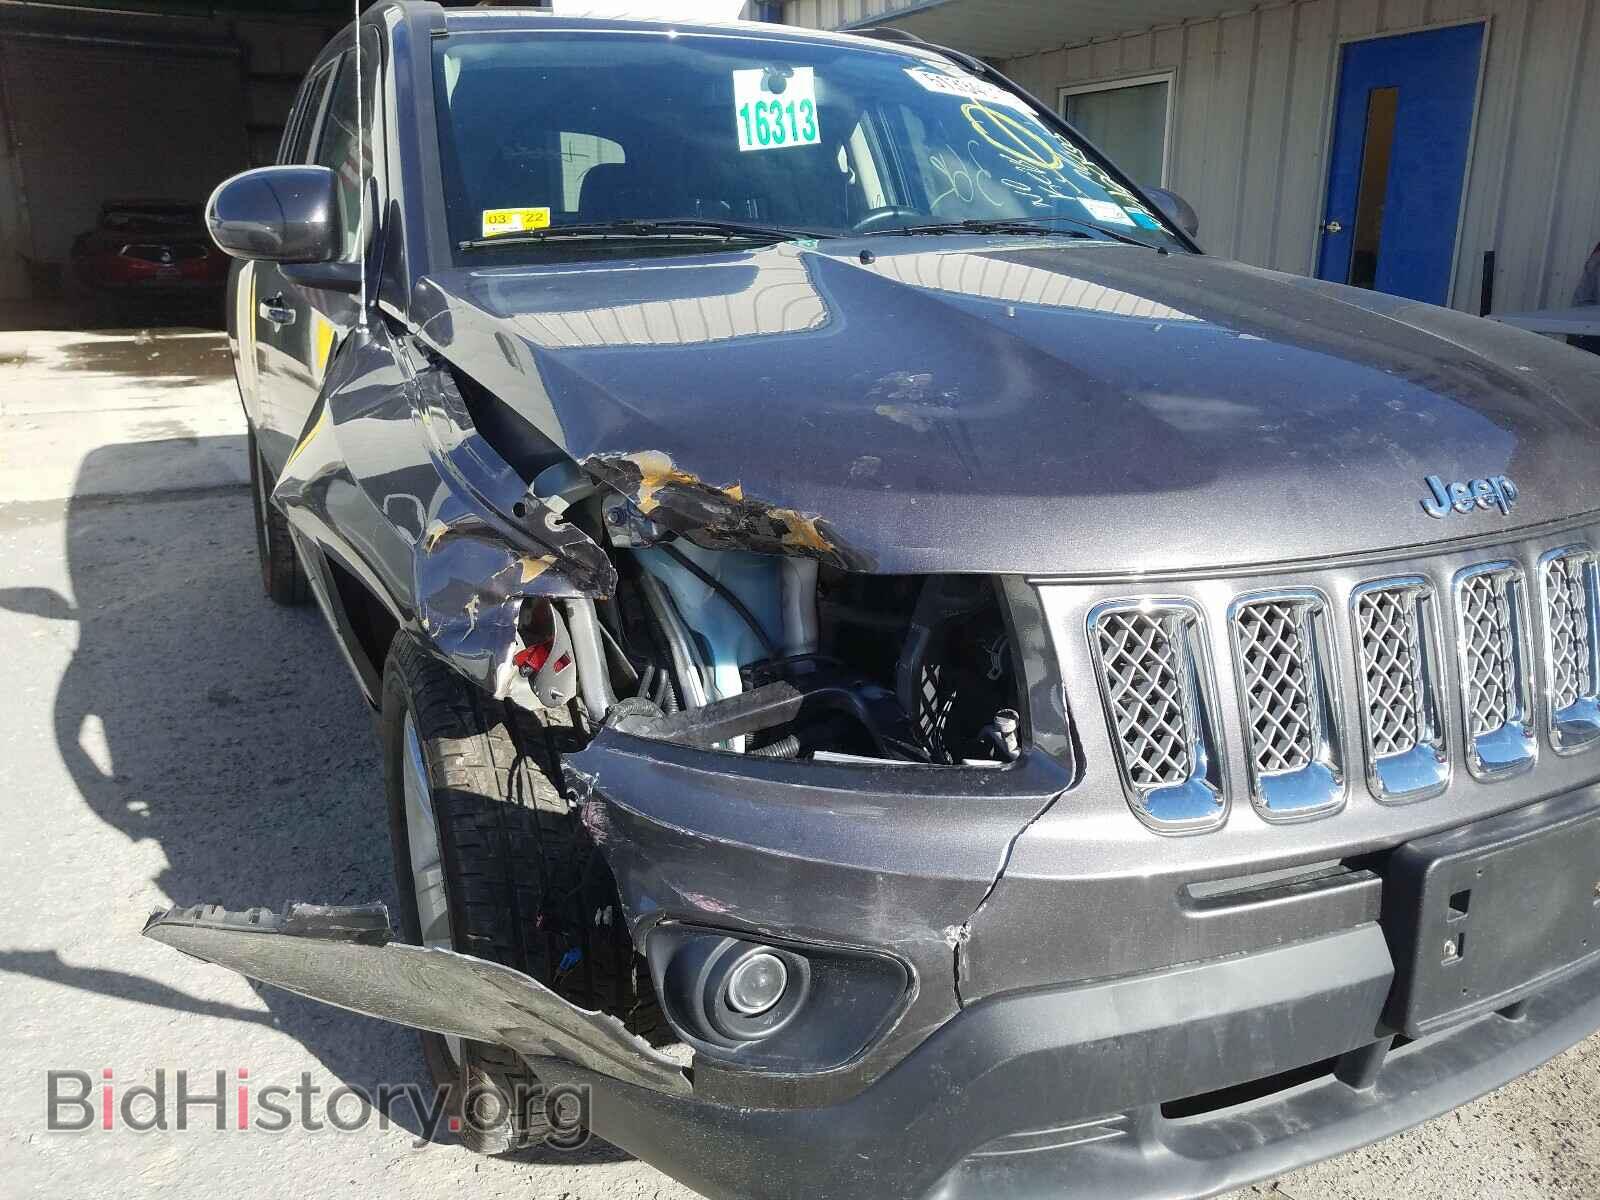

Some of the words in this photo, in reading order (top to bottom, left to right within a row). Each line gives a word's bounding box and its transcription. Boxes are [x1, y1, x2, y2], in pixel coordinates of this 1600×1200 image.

[739, 98, 816, 146] 16313
[488, 214, 506, 224] 03
[525, 212, 544, 223] 22
[1419, 474, 1519, 519] Jeep
